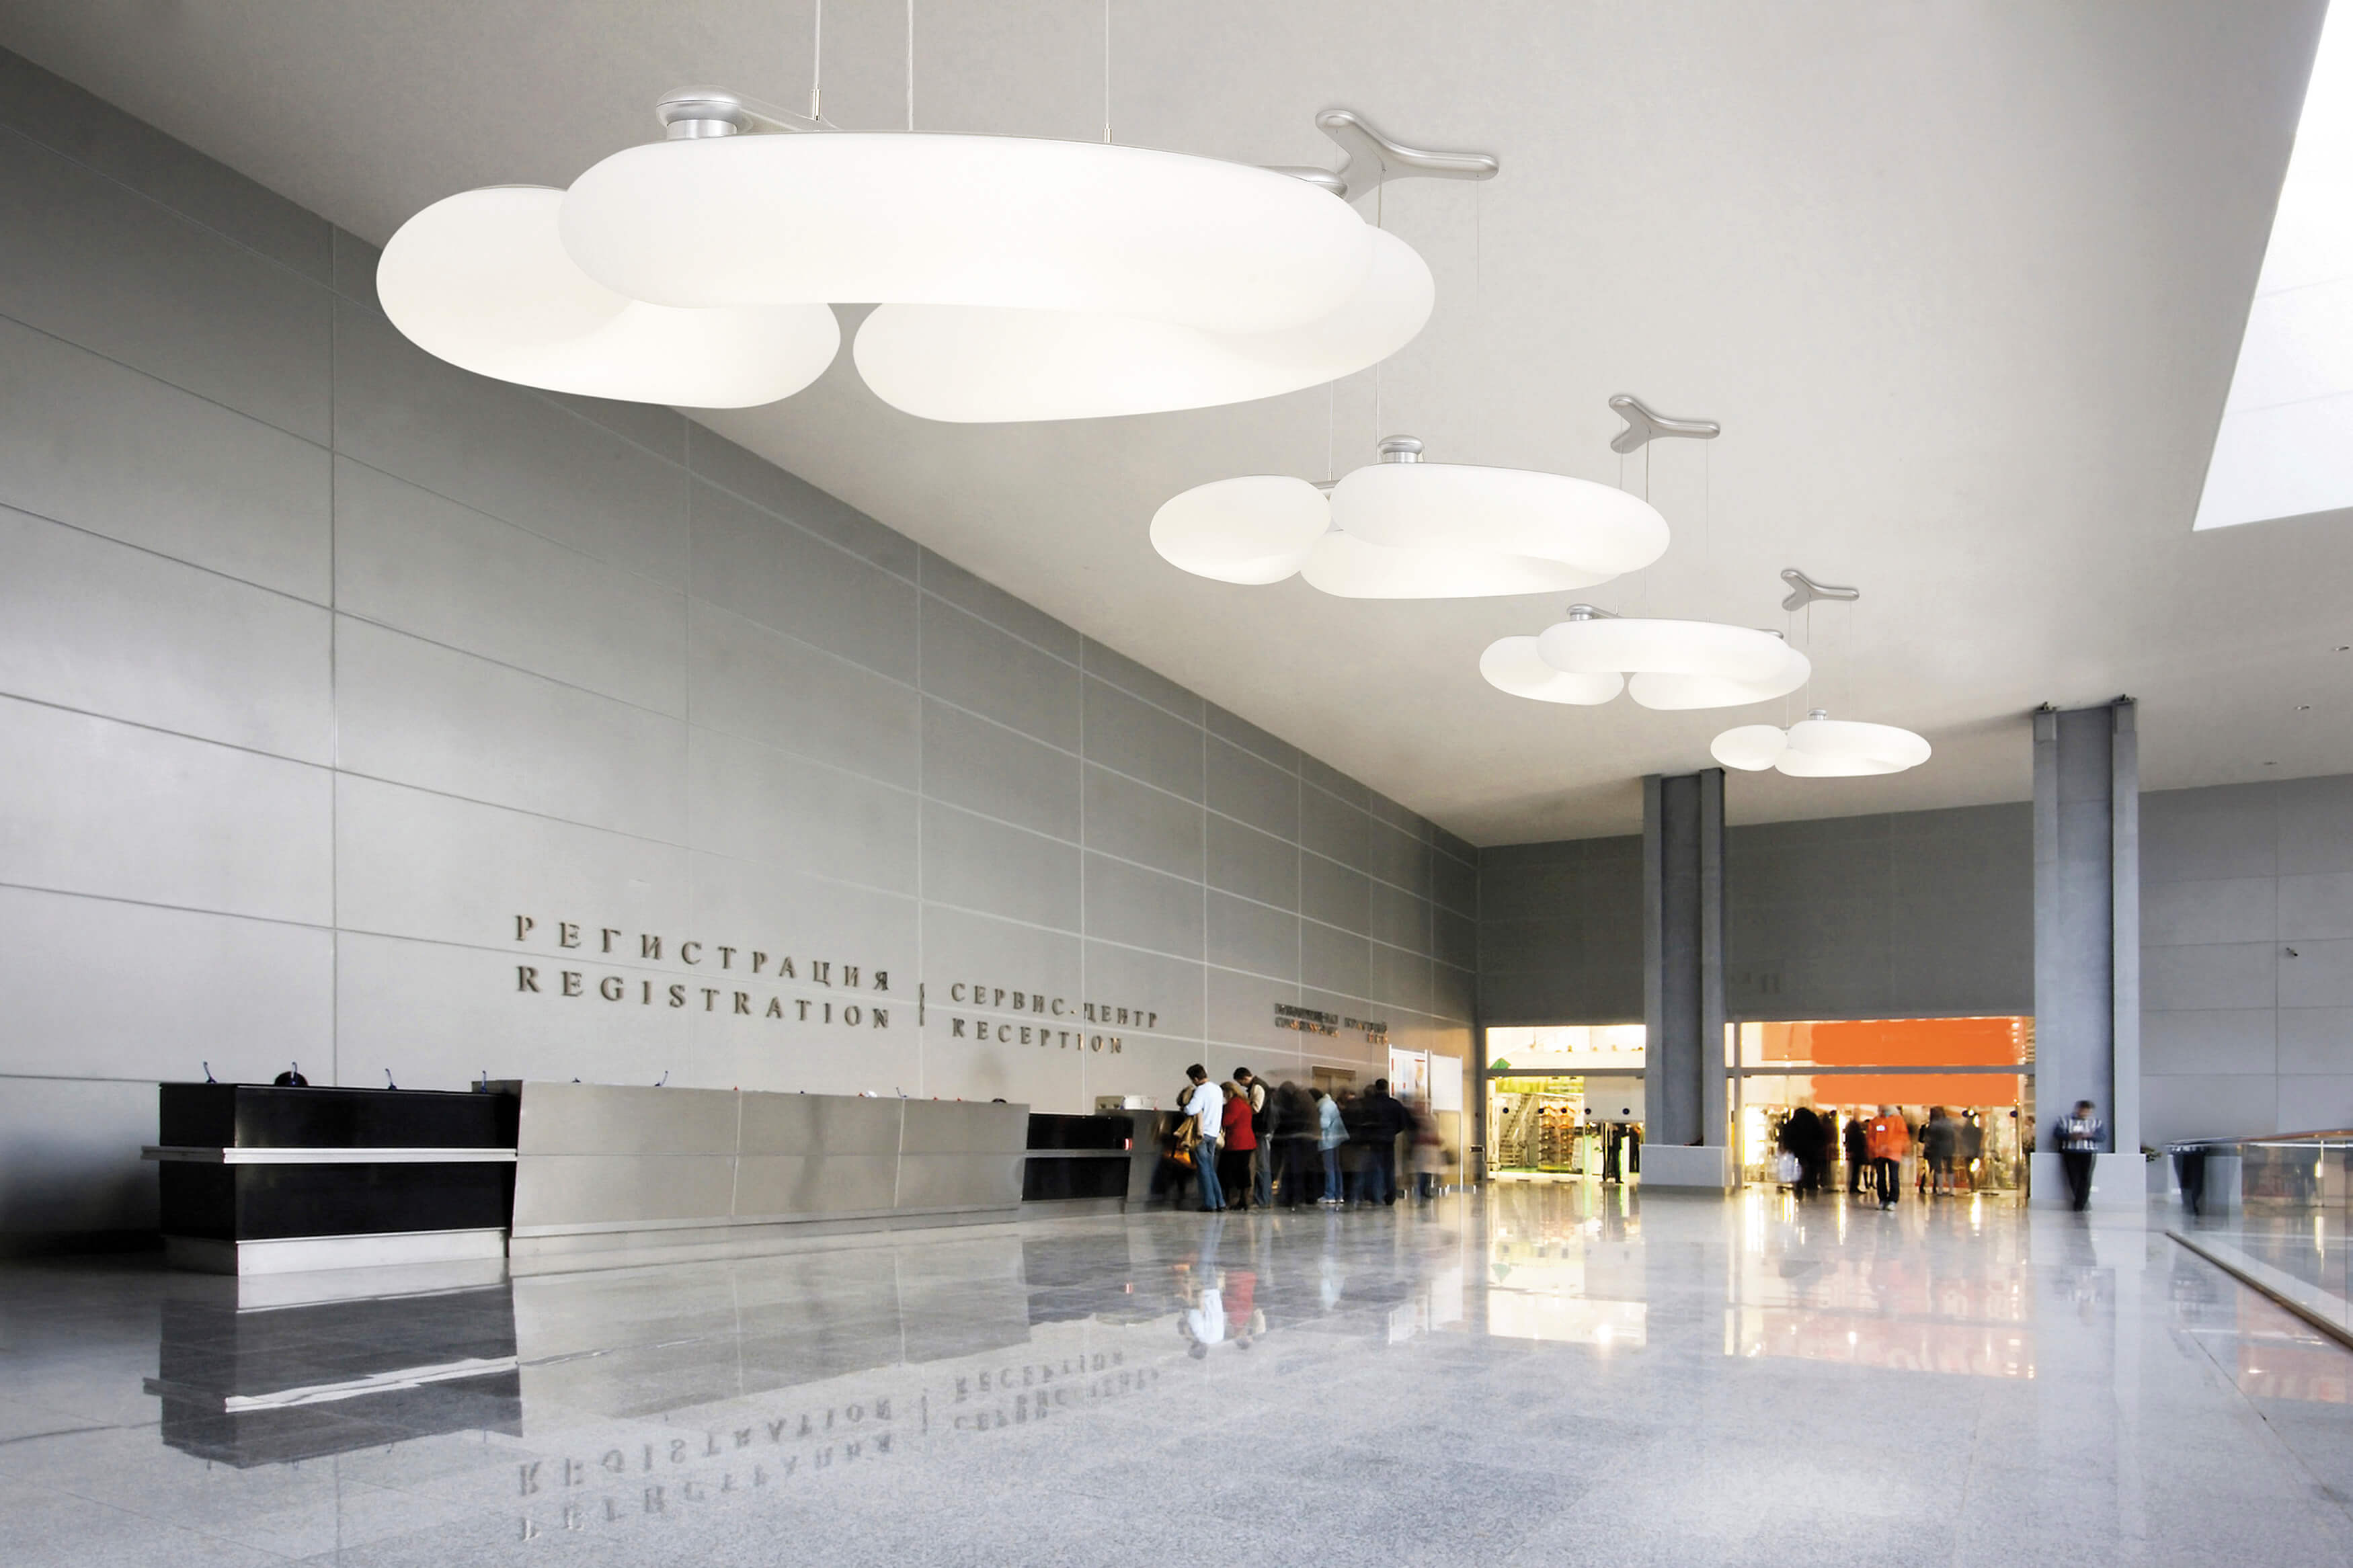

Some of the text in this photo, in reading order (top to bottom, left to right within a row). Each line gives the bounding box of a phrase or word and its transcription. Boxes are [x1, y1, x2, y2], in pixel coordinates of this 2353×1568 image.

[515, 915, 889, 991] РЕГИСТРАЦИЯ
[516, 966, 889, 1028] REGISTRATION
[952, 1018, 1122, 1054] RECEPTION
